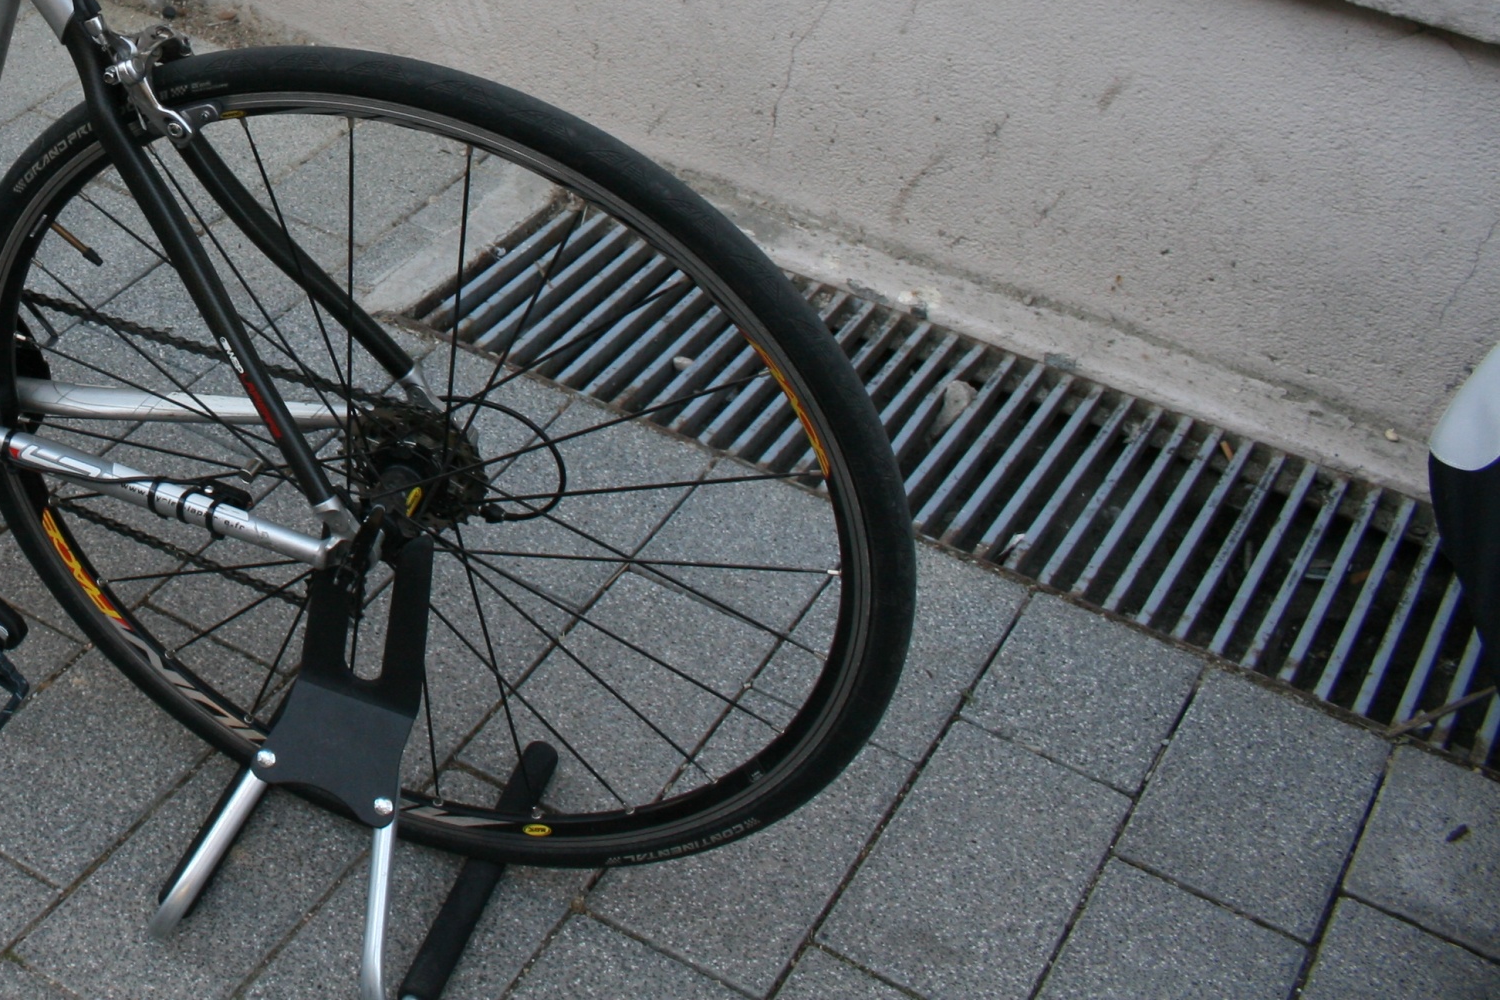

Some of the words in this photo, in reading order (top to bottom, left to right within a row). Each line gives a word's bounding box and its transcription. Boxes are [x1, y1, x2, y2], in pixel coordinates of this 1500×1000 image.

[24, 138, 69, 183] GRAND
[67, 121, 93, 147] PRI
[622, 823, 745, 863] CONTINENTAL
